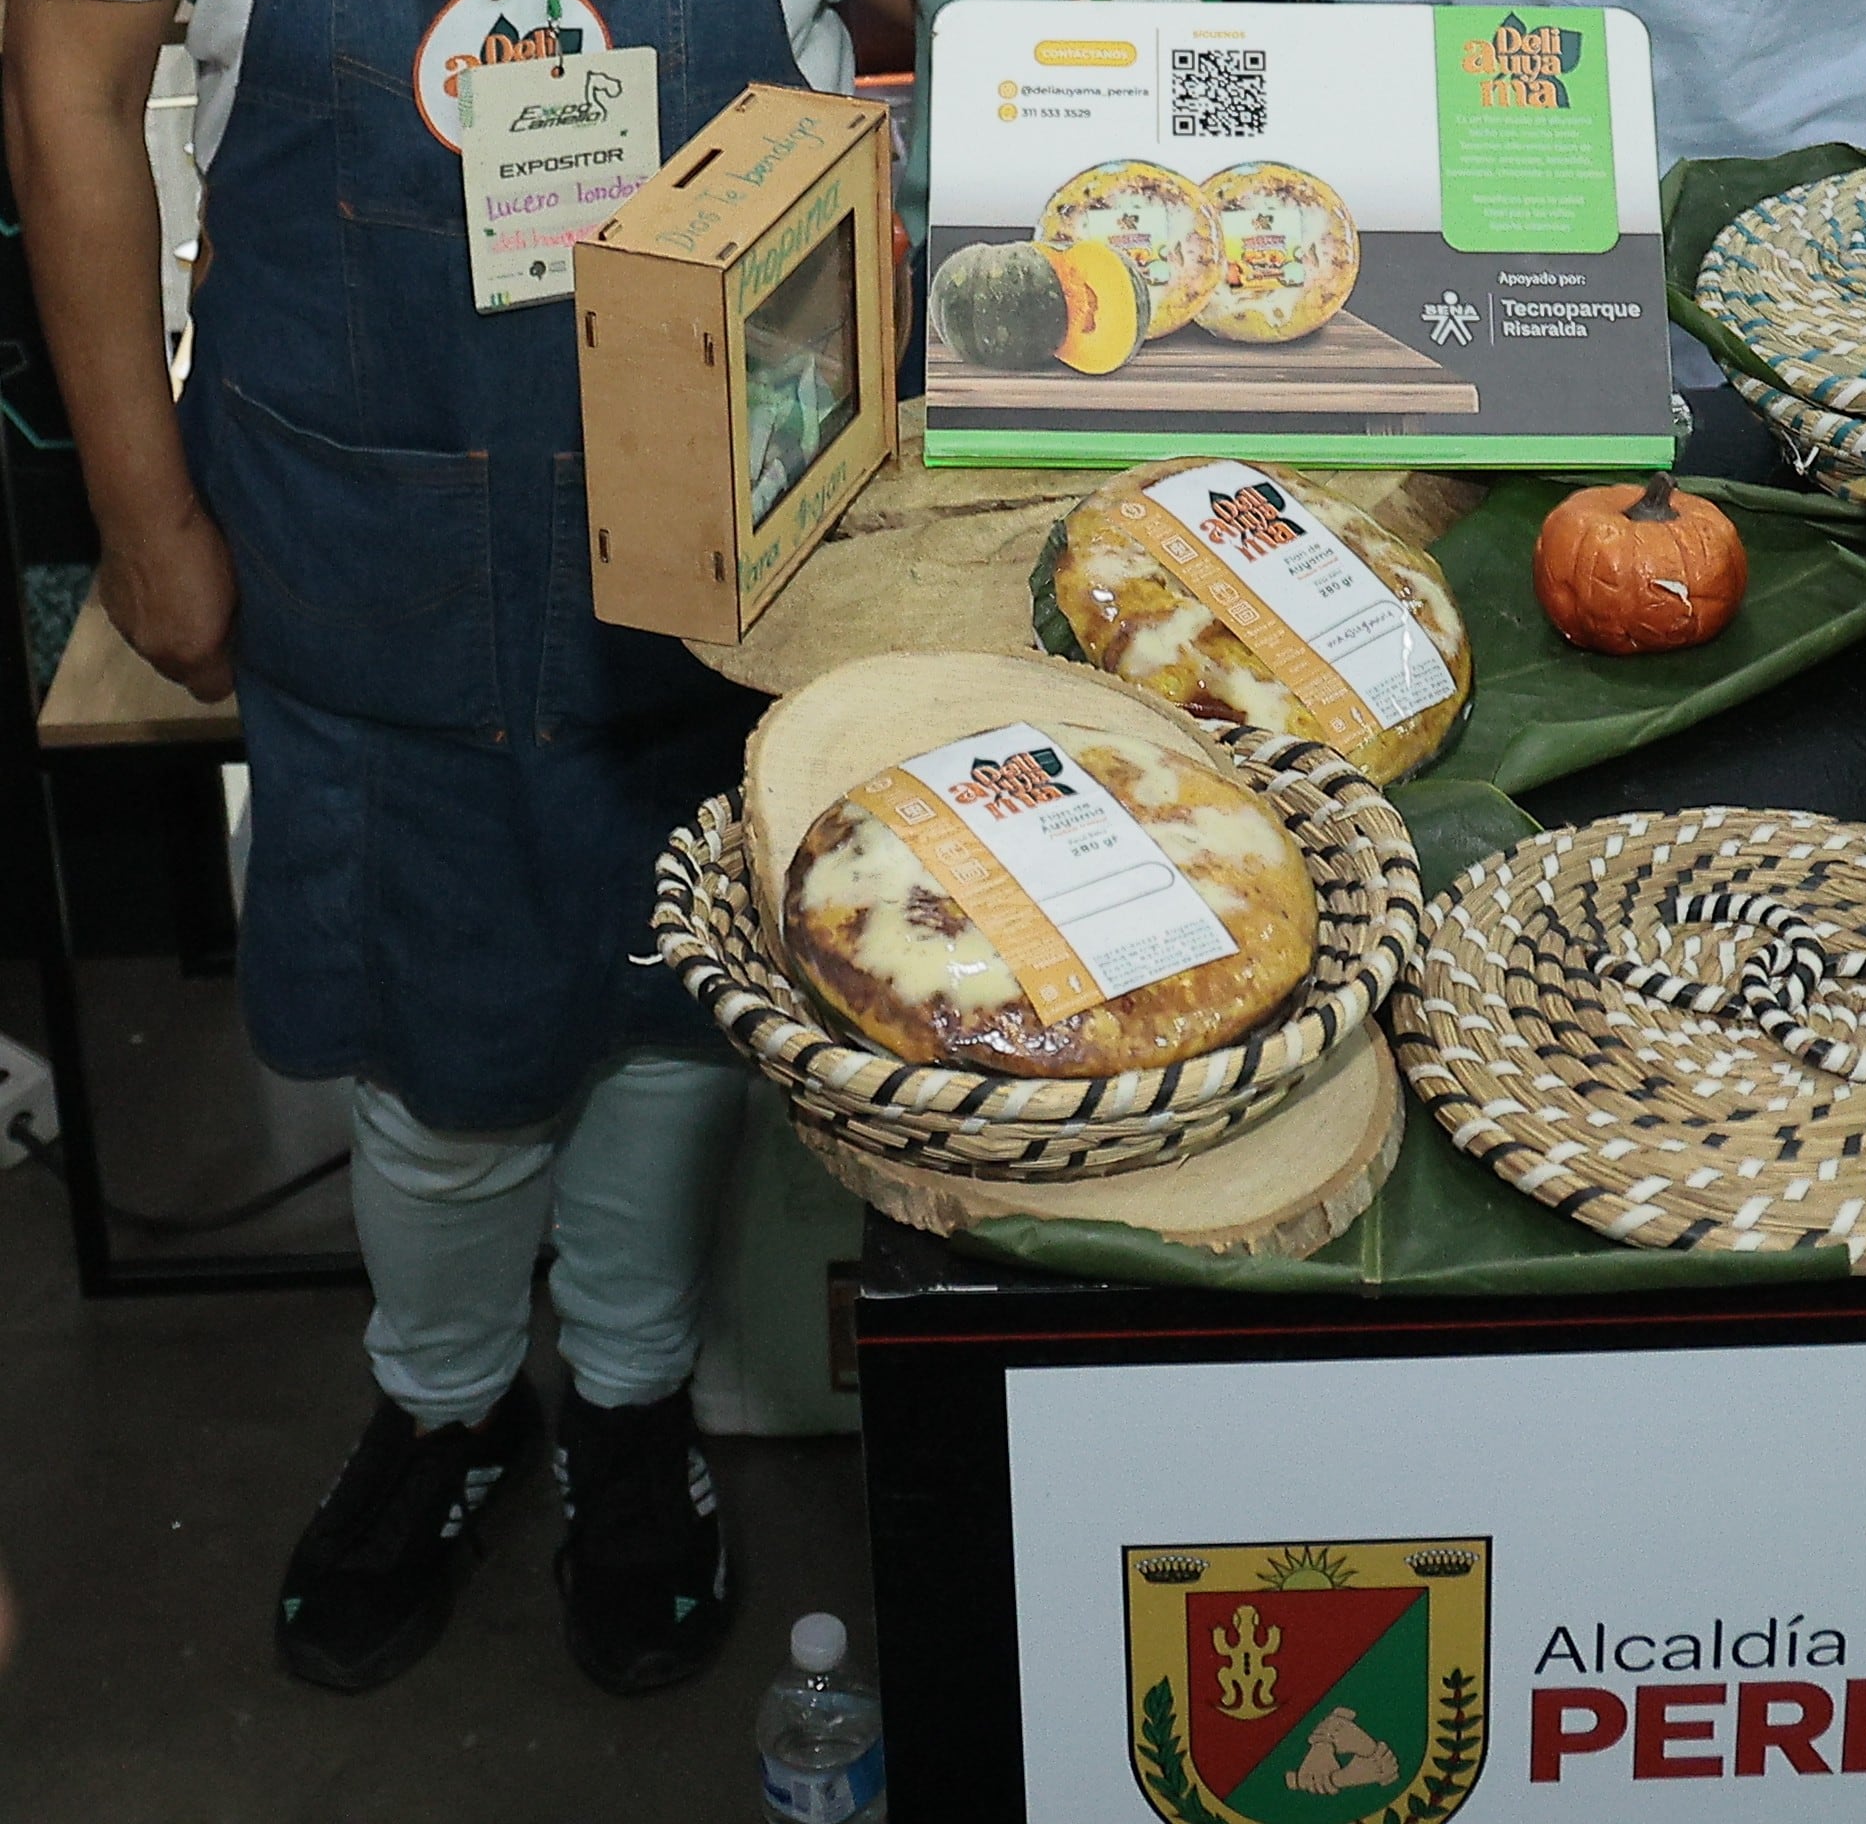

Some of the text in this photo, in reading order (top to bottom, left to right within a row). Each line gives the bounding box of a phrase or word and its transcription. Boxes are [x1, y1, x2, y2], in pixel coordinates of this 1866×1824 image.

[1497, 26, 1563, 55] Deli
[1041, 108, 1061, 120] 533
[1064, 108, 1092, 120] 3529
[500, 148, 625, 179] EXPOSITOR
[486, 191, 560, 222] Lucero
[1499, 271, 1587, 288] Apoyado por:
[1423, 304, 1479, 316] SENA
[1500, 298, 1642, 321] Tecnoparque
[1502, 321, 1589, 337] Risaralda
[1533, 1613, 1848, 1677] Alcaldía
